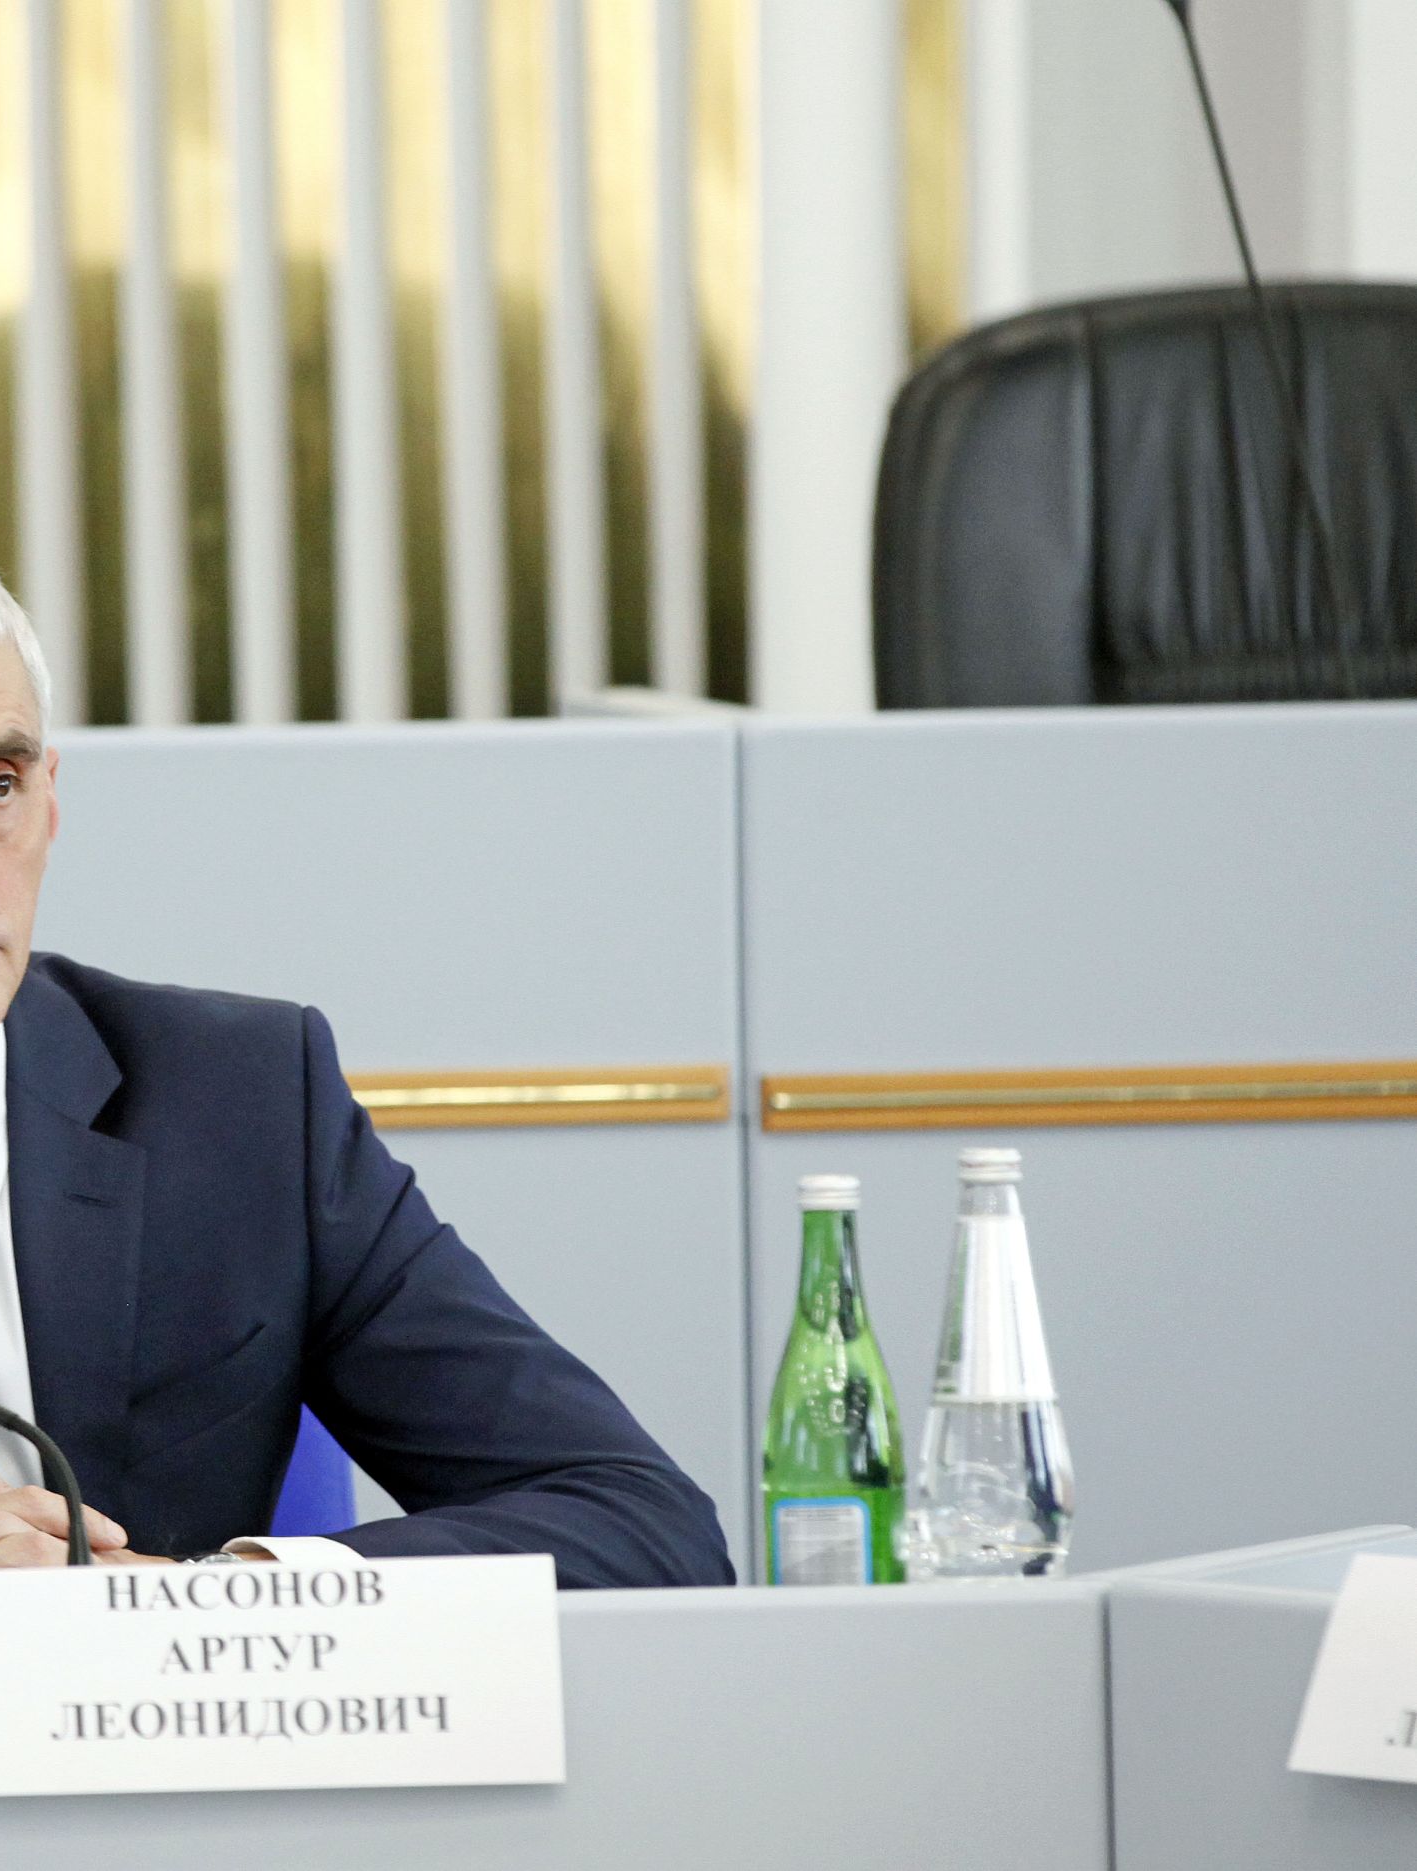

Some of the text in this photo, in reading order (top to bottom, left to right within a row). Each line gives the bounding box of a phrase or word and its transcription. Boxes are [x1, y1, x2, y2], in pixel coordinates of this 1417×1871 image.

[106, 1570, 385, 1610] НАСОНОВ
[162, 1634, 338, 1674] АРТУР
[52, 1696, 451, 1741] ЛЕОНИДОВИЧ
